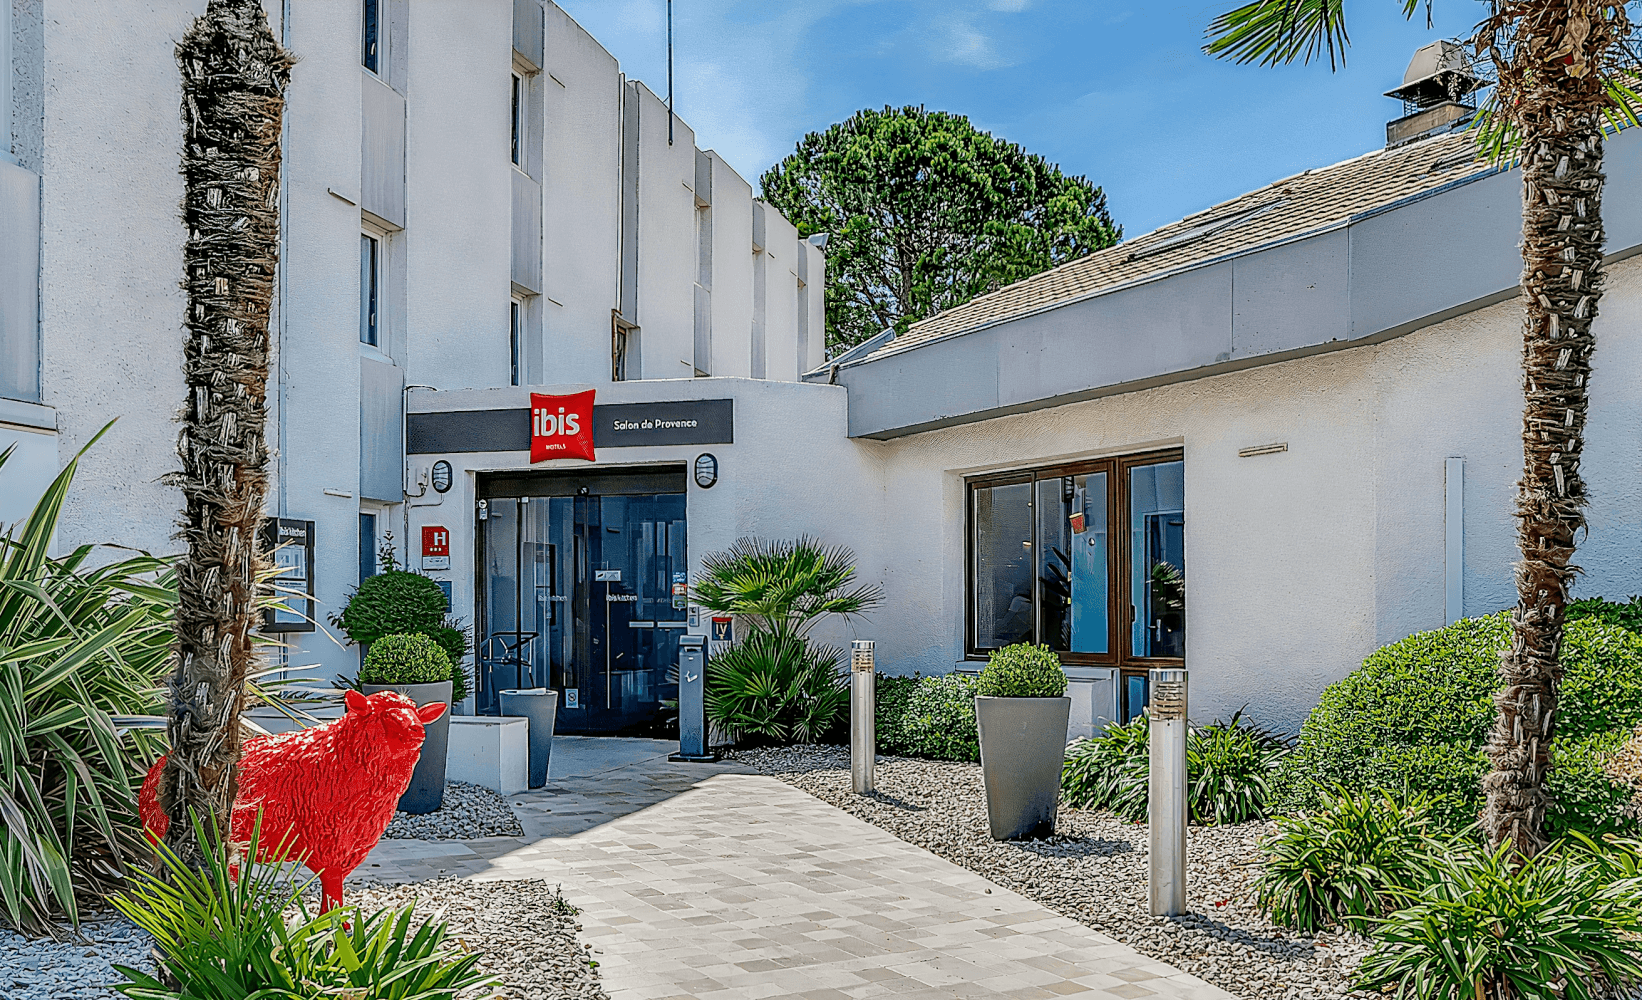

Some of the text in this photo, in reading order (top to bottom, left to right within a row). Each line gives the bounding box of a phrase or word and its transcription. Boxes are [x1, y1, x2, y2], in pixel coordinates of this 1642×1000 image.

[534, 407, 580, 436] ibis
[613, 419, 698, 430] Salon de Provence
[434, 532, 447, 546] H
